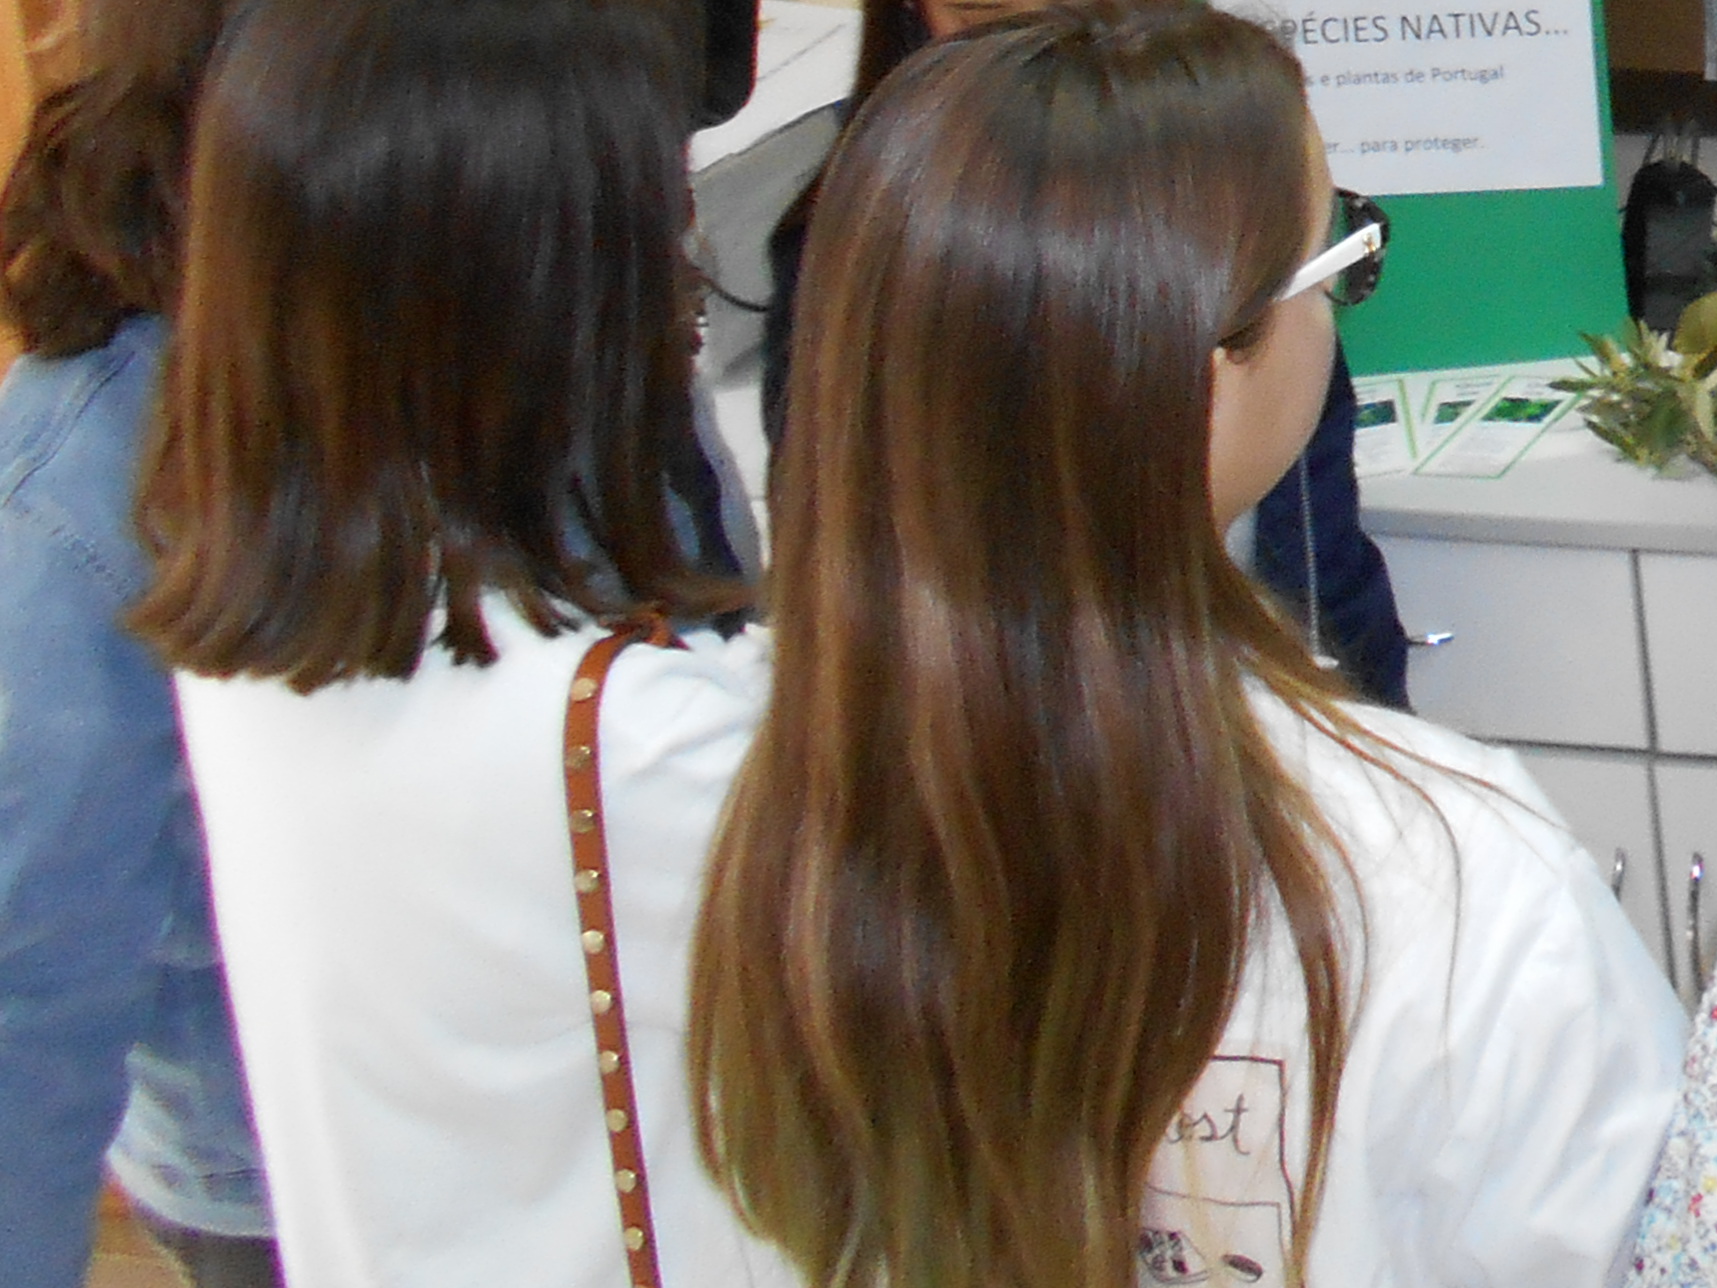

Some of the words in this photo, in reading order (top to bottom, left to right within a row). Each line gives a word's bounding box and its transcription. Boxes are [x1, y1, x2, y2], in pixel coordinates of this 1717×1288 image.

[1263, 10, 1389, 45] PÉCIES
[1336, 69, 1399, 88] plantas
[1404, 68, 1425, 83] de
[1431, 65, 1504, 86] Portugal
[1361, 139, 1398, 154] para
